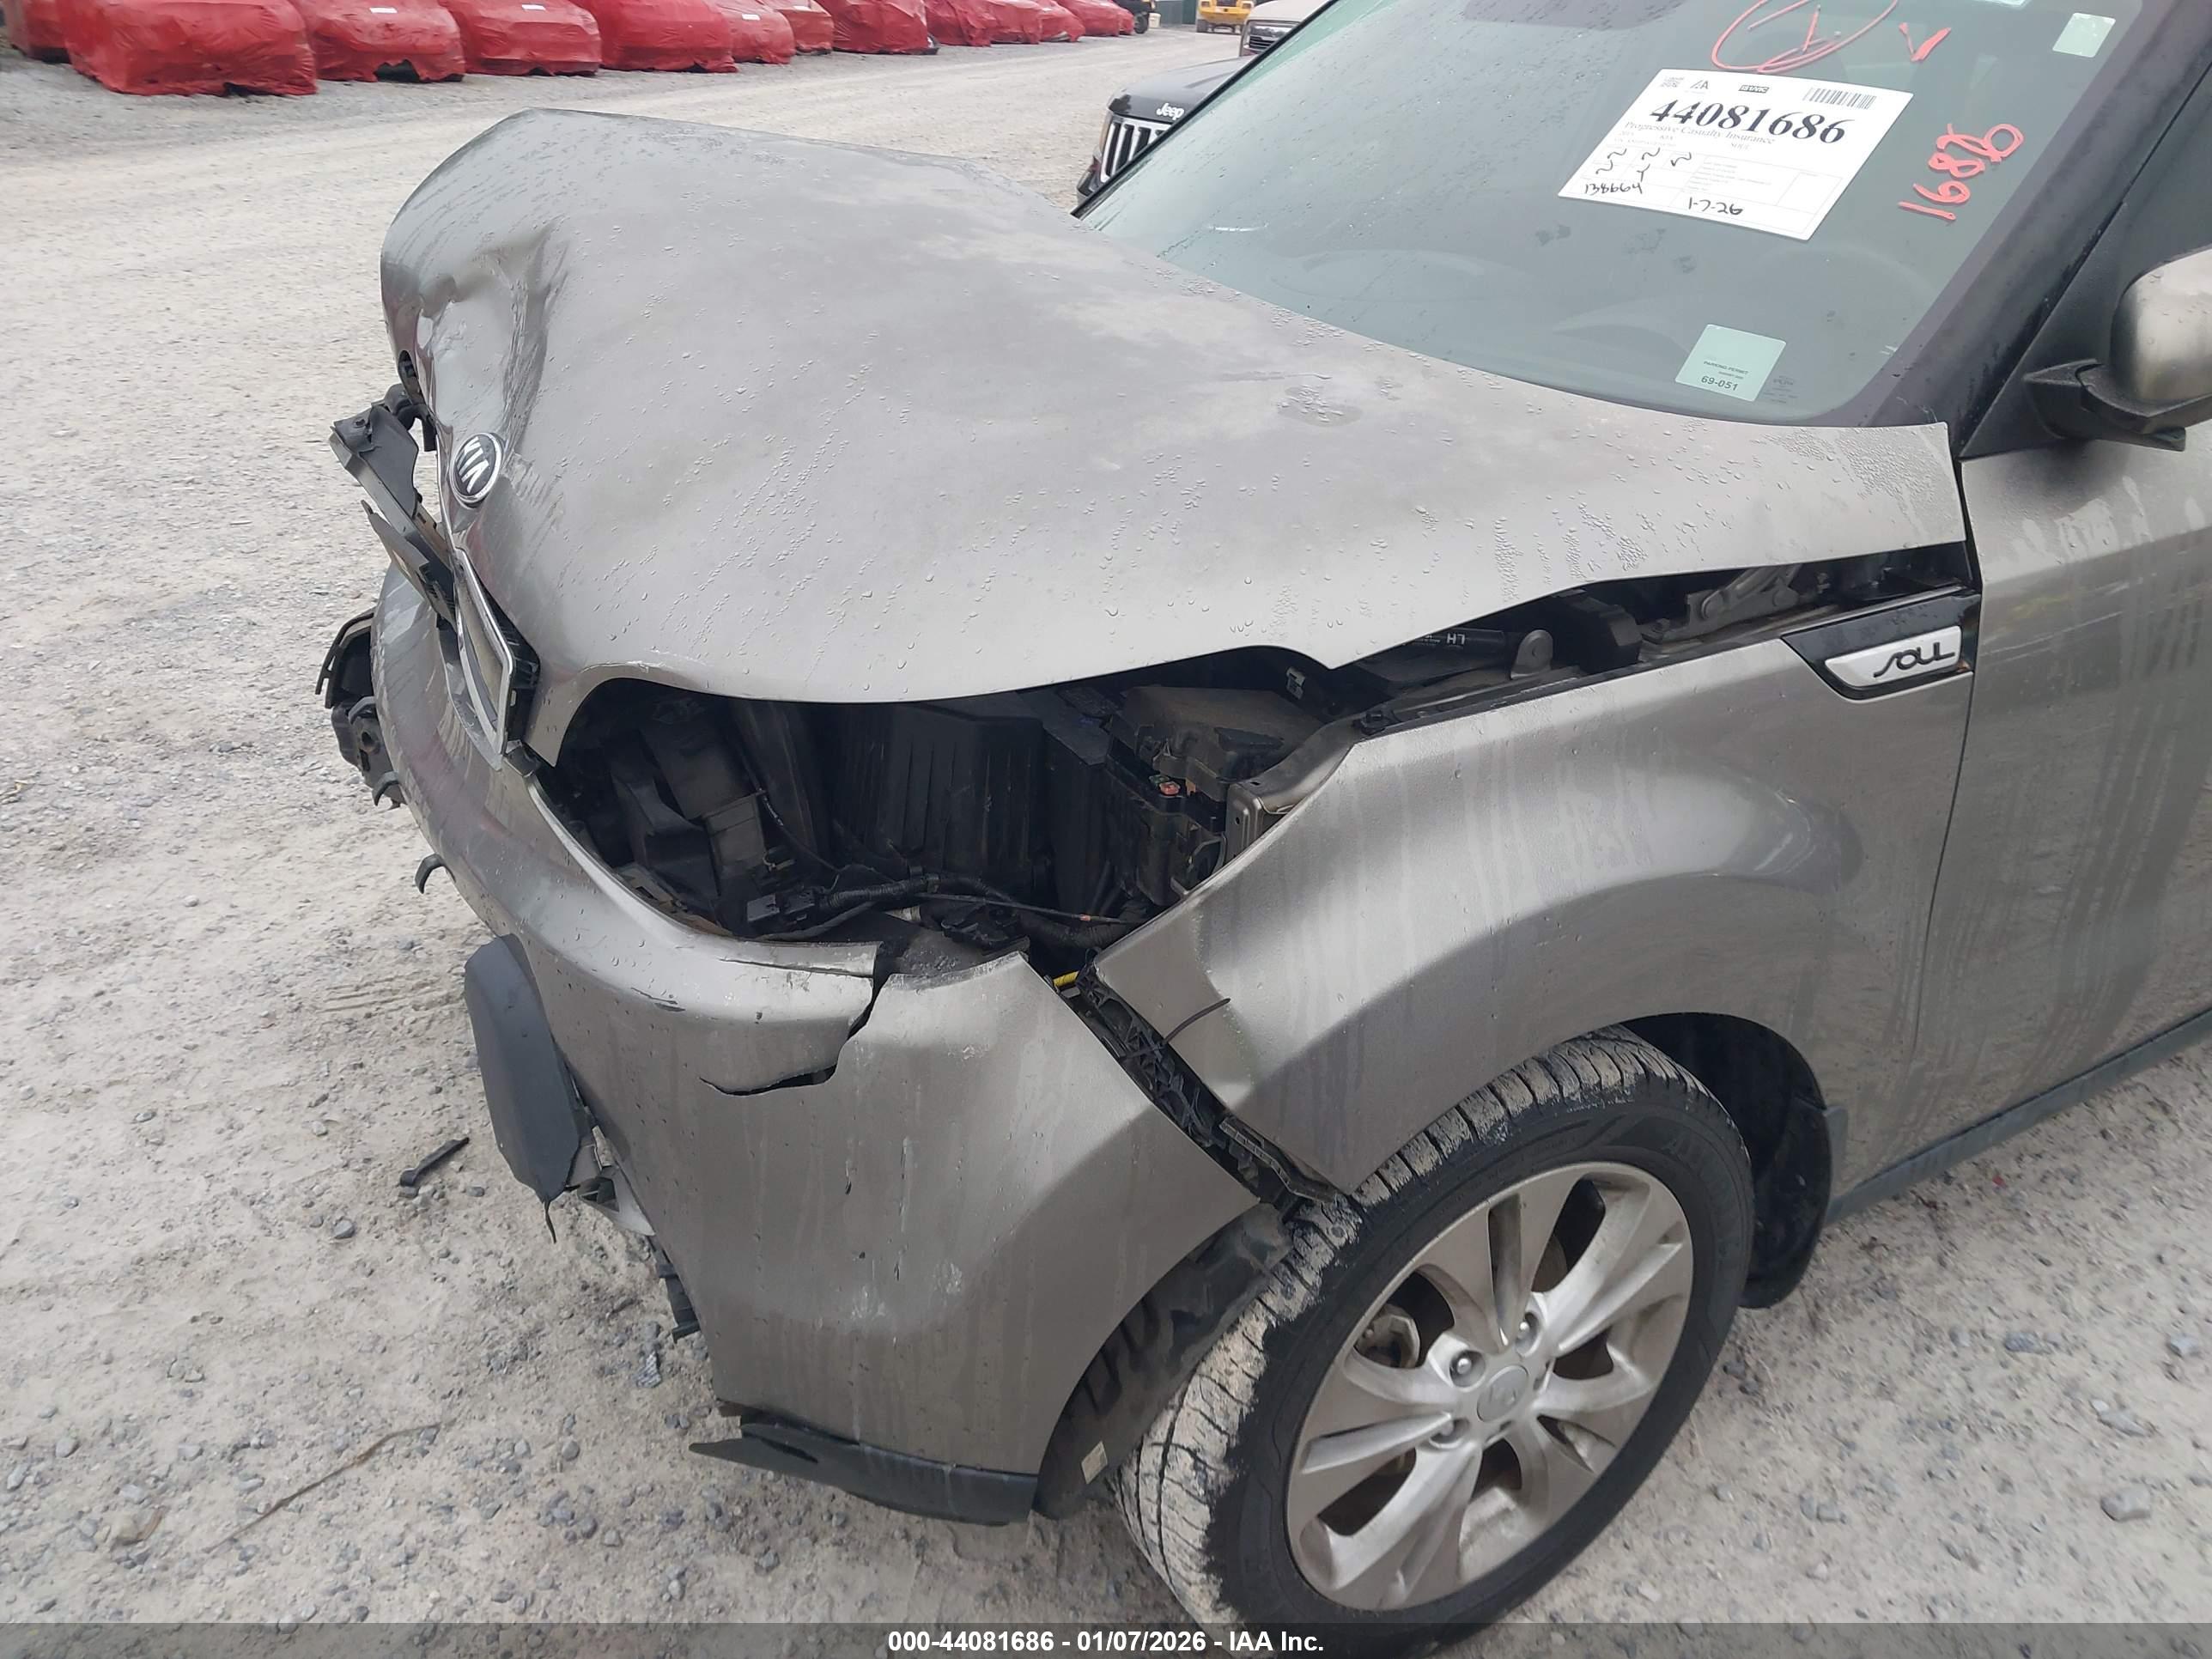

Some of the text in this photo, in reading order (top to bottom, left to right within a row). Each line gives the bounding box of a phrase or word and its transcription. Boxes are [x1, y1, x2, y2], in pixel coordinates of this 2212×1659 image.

[1156, 102, 1185, 120] Jeep
[1651, 99, 1855, 144] 44081686
[1625, 120, 1776, 145] Progressive Casualty Insurance
[1703, 360, 1728, 370] PARKING
[1701, 375, 1739, 391] 69-051
